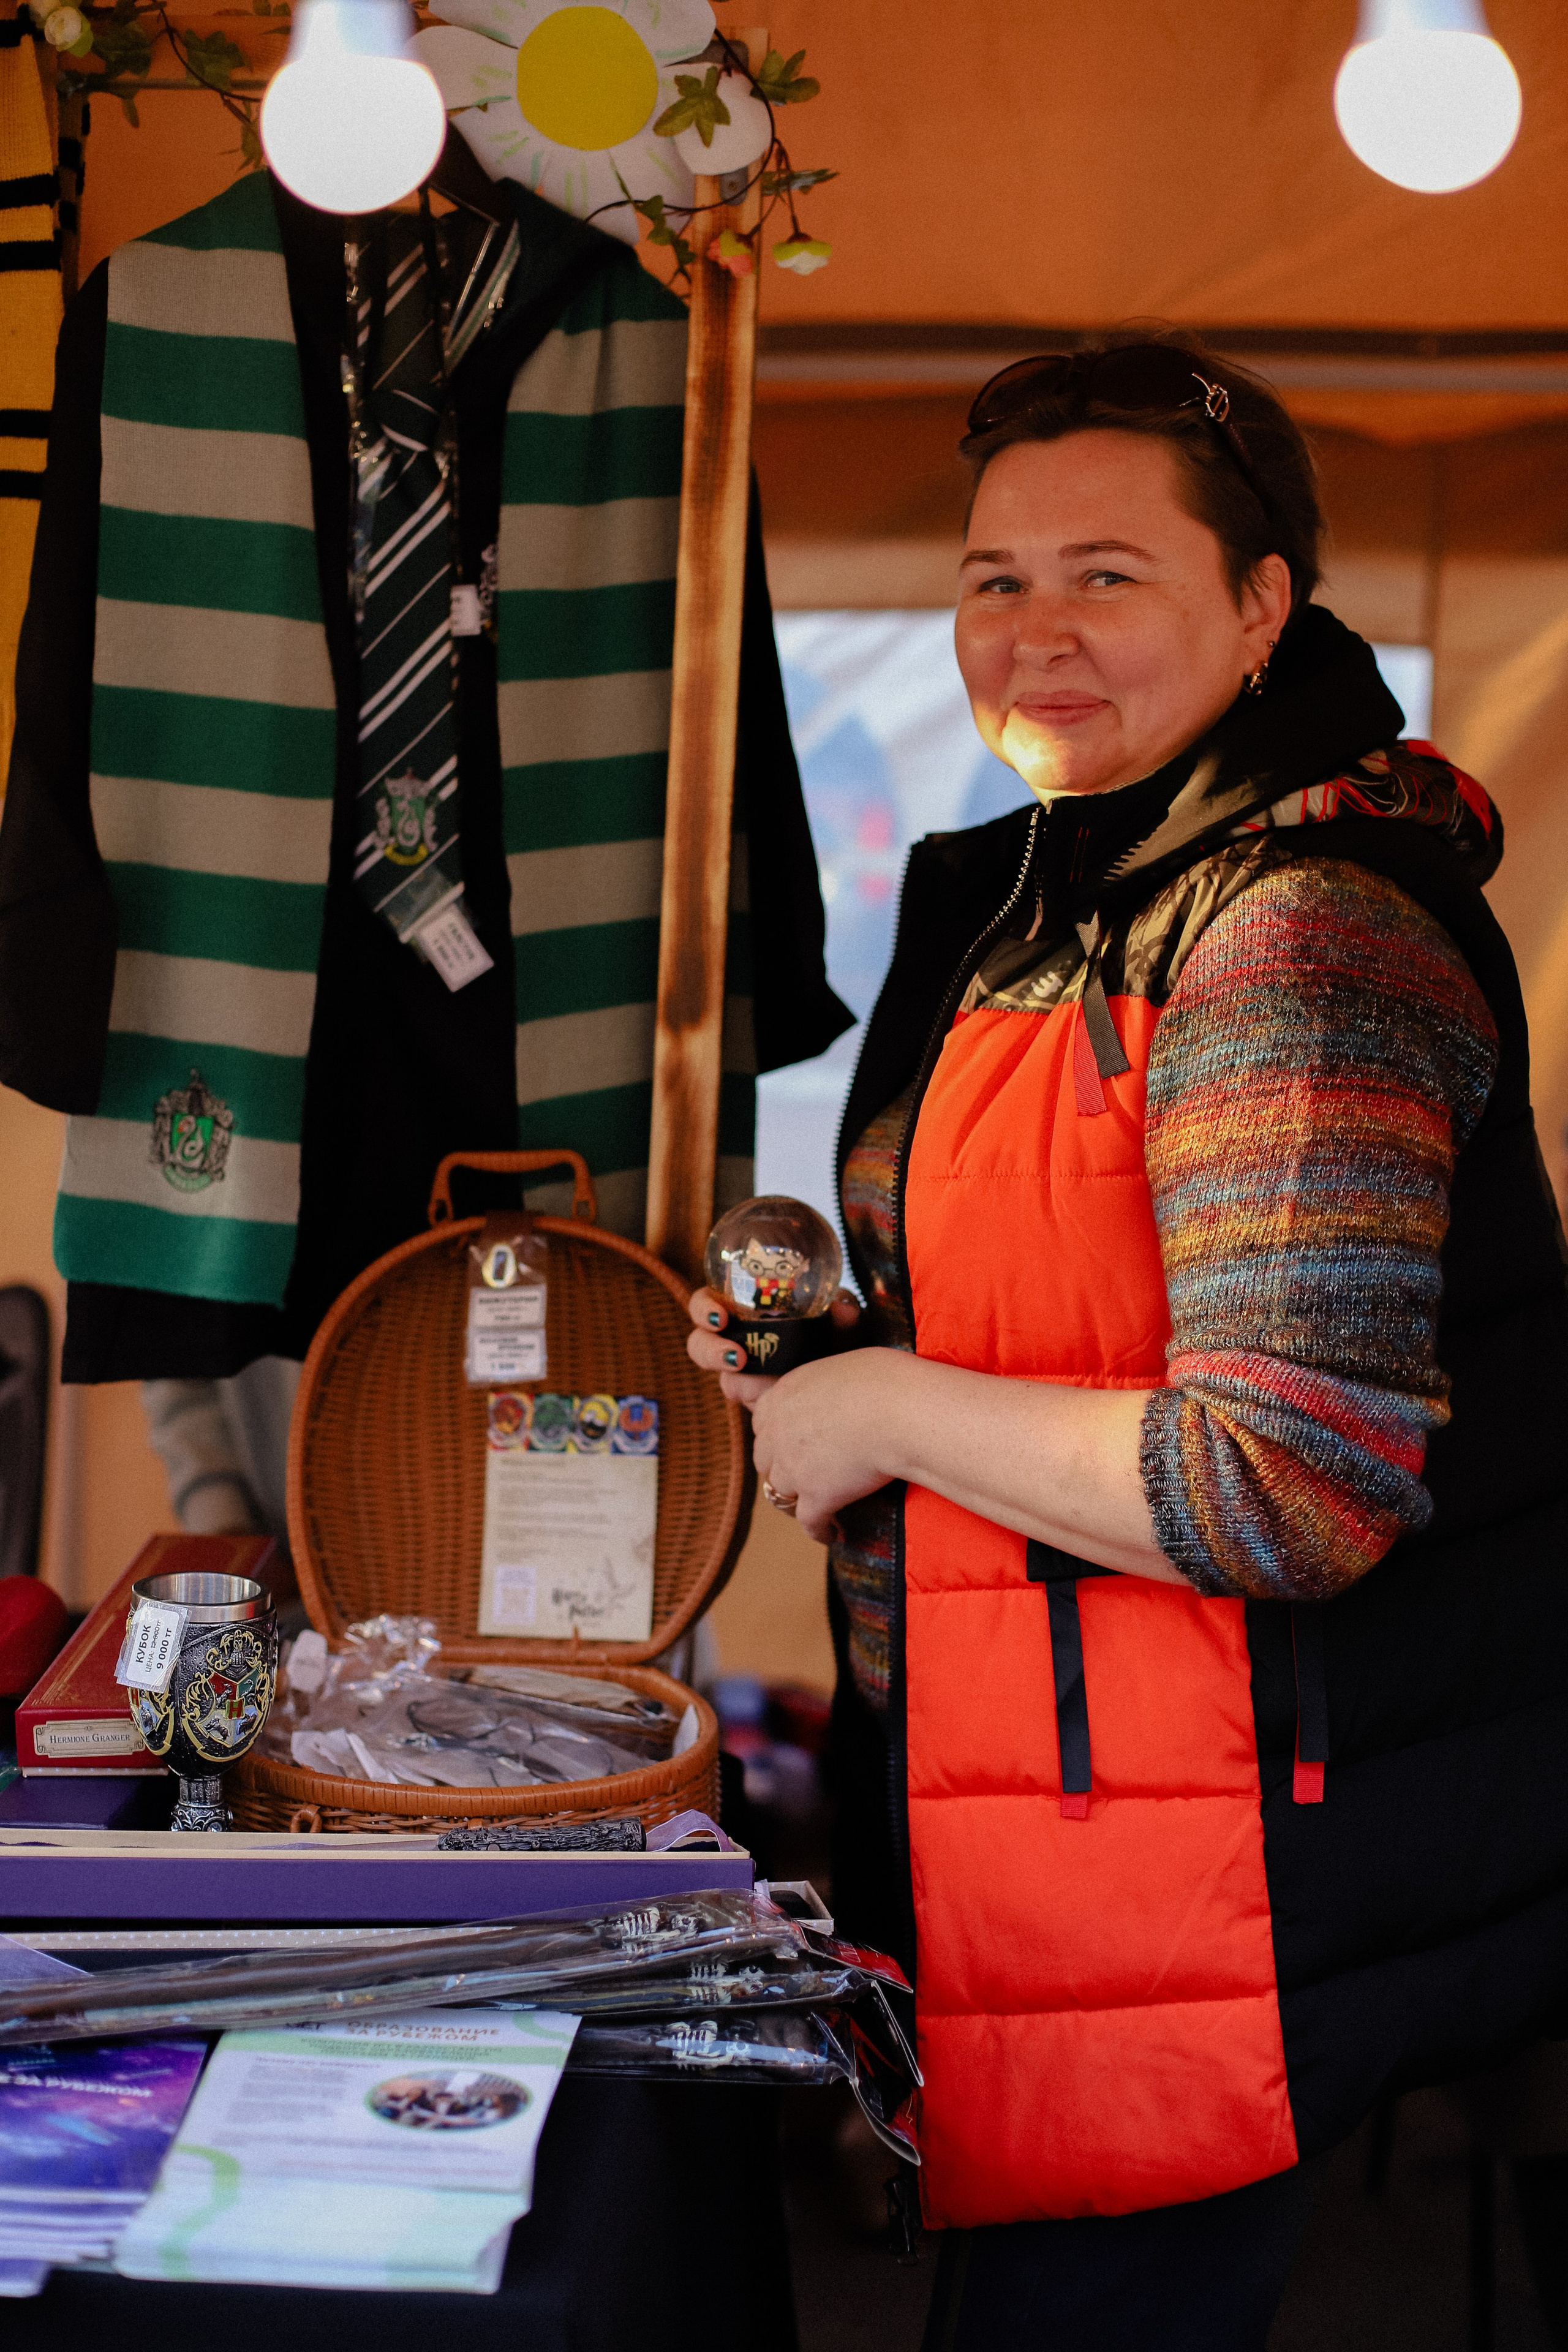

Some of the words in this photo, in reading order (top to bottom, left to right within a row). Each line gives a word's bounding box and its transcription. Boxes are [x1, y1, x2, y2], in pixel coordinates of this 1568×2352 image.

[745, 1332, 780, 1366] HP
[135, 1624, 151, 1663] КУБОК
[158, 1640, 169, 1660] 000
[165, 1627, 172, 1638] тг
[145, 1651, 155, 1672] ЦЕНА:
[49, 1733, 90, 1744] HERMIONE
[92, 1733, 130, 1742] GRANGER
[347, 2021, 500, 2036] ОБРАЗОВАНИЕ
[375, 2030, 478, 2041] РУБЕЖОМ
[45, 2076, 152, 2097] РУБЕЖОМ
